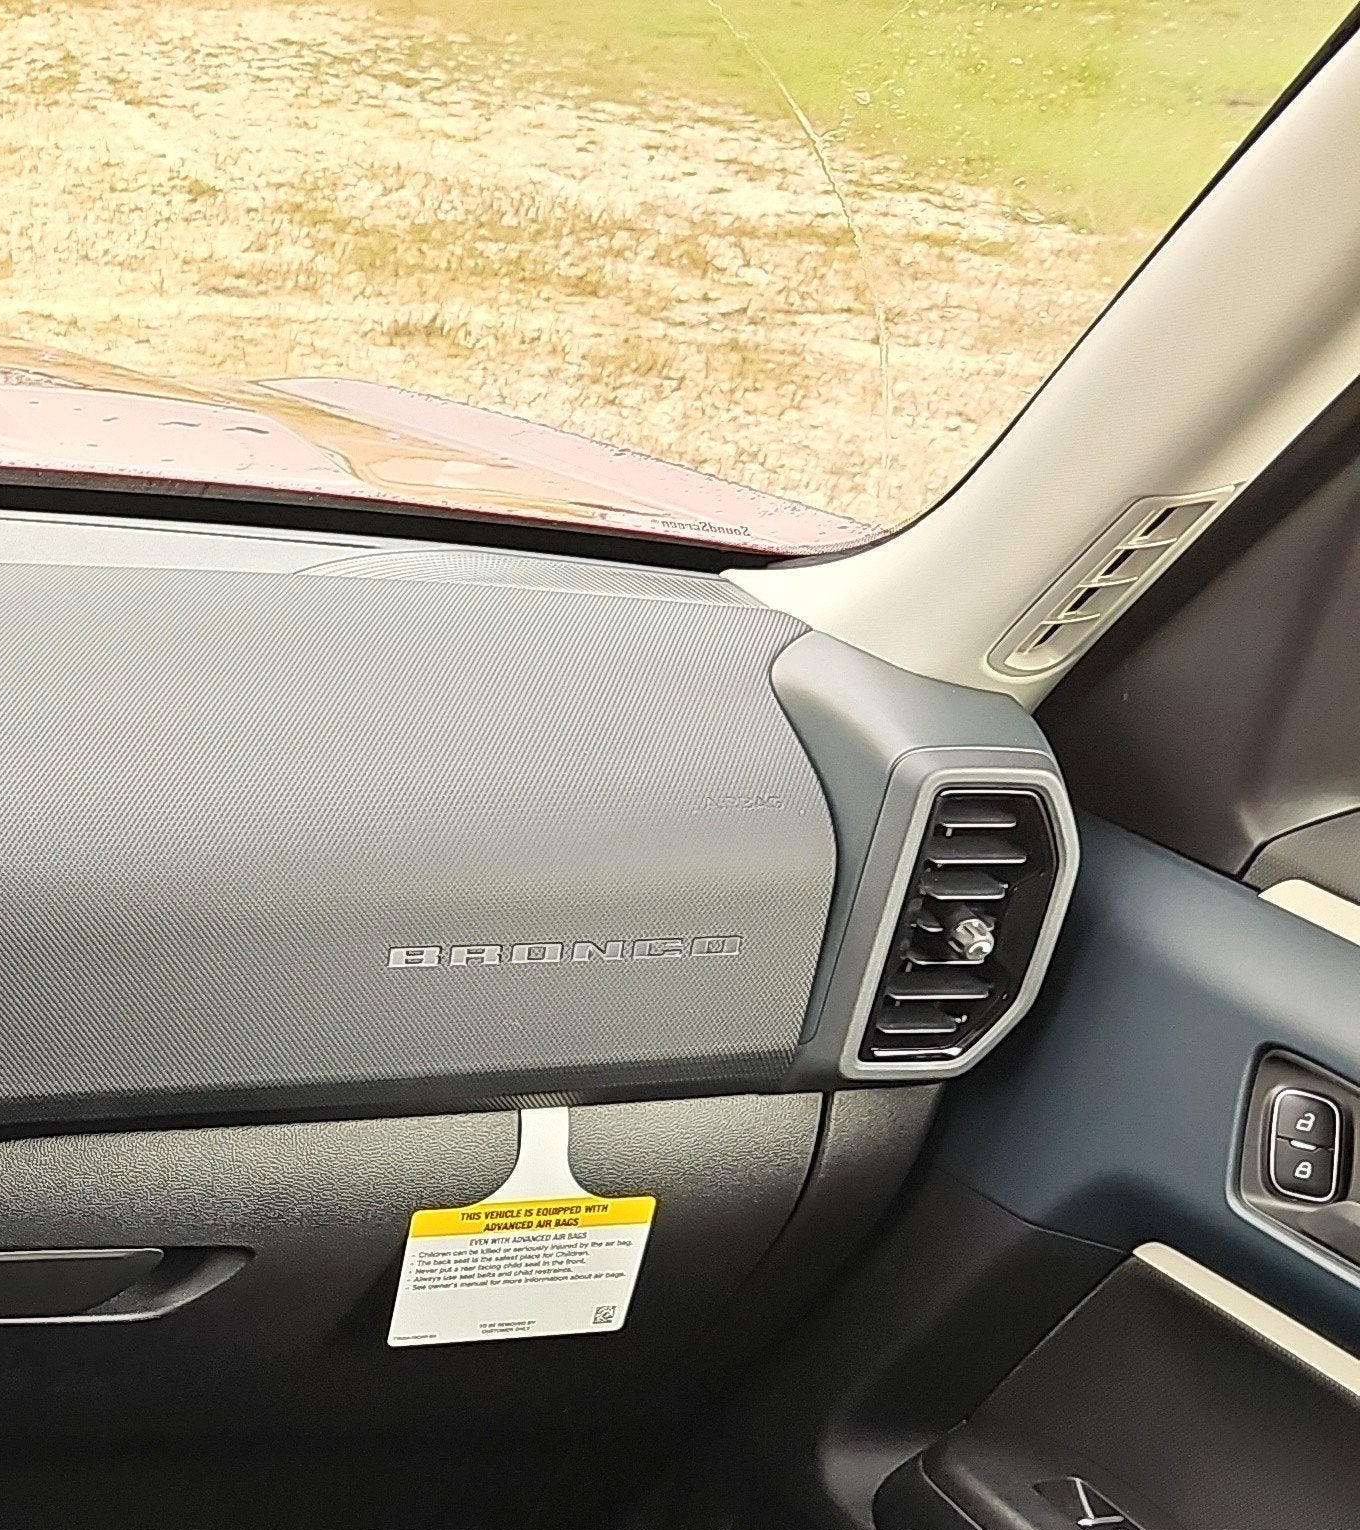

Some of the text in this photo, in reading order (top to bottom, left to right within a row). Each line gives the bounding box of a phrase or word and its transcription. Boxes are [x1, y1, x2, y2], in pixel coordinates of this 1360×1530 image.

[387, 936, 742, 968] BRONCO
[461, 1204, 609, 1221] THIS VEHICLE IS EQUIPPED WITH
[483, 1218, 579, 1232] ADVANCED AIR BAGS
[469, 1232, 587, 1246] EVEN WITH ADVANCED AIR BAGS
